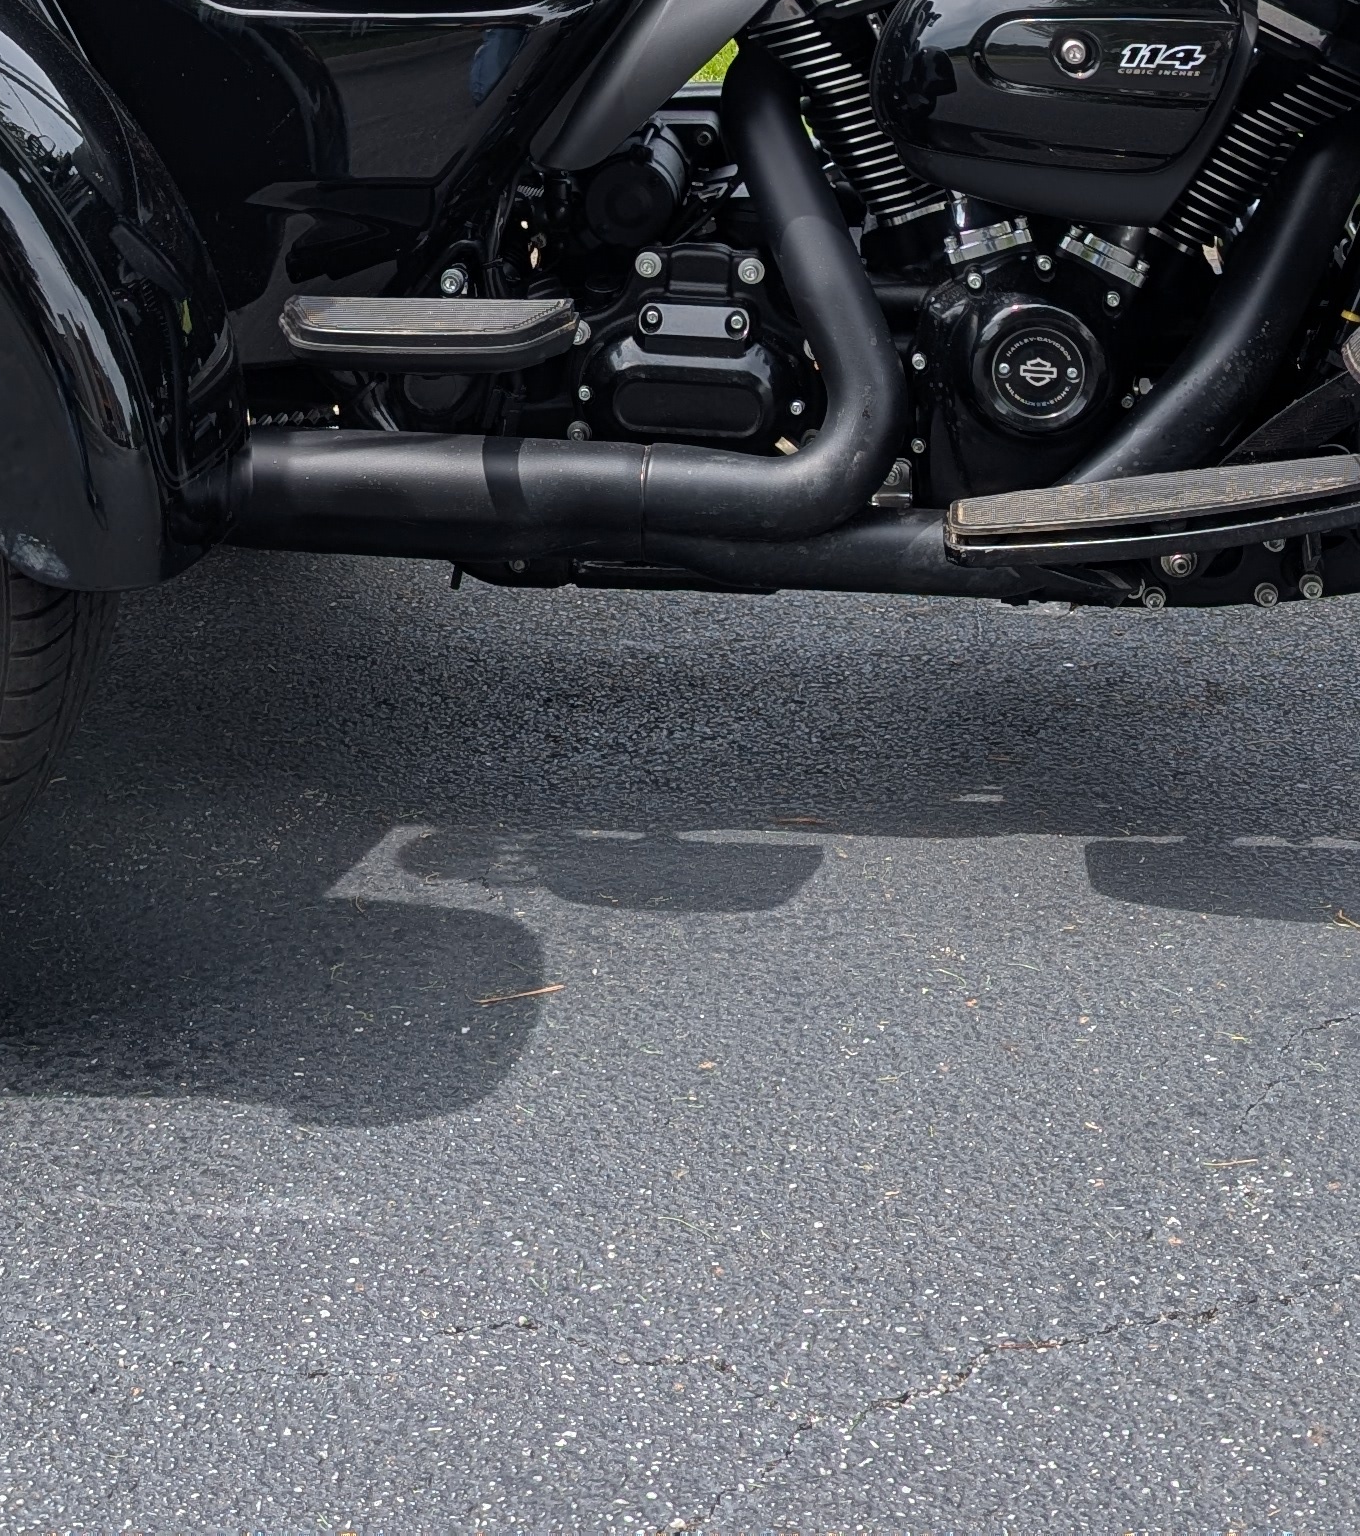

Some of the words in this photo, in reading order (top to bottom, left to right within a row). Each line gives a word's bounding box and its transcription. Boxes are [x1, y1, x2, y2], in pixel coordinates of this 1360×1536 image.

[1119, 43, 1207, 70] 114
[1117, 68, 1153, 76] CUBIC
[1158, 69, 1201, 77] INCHES
